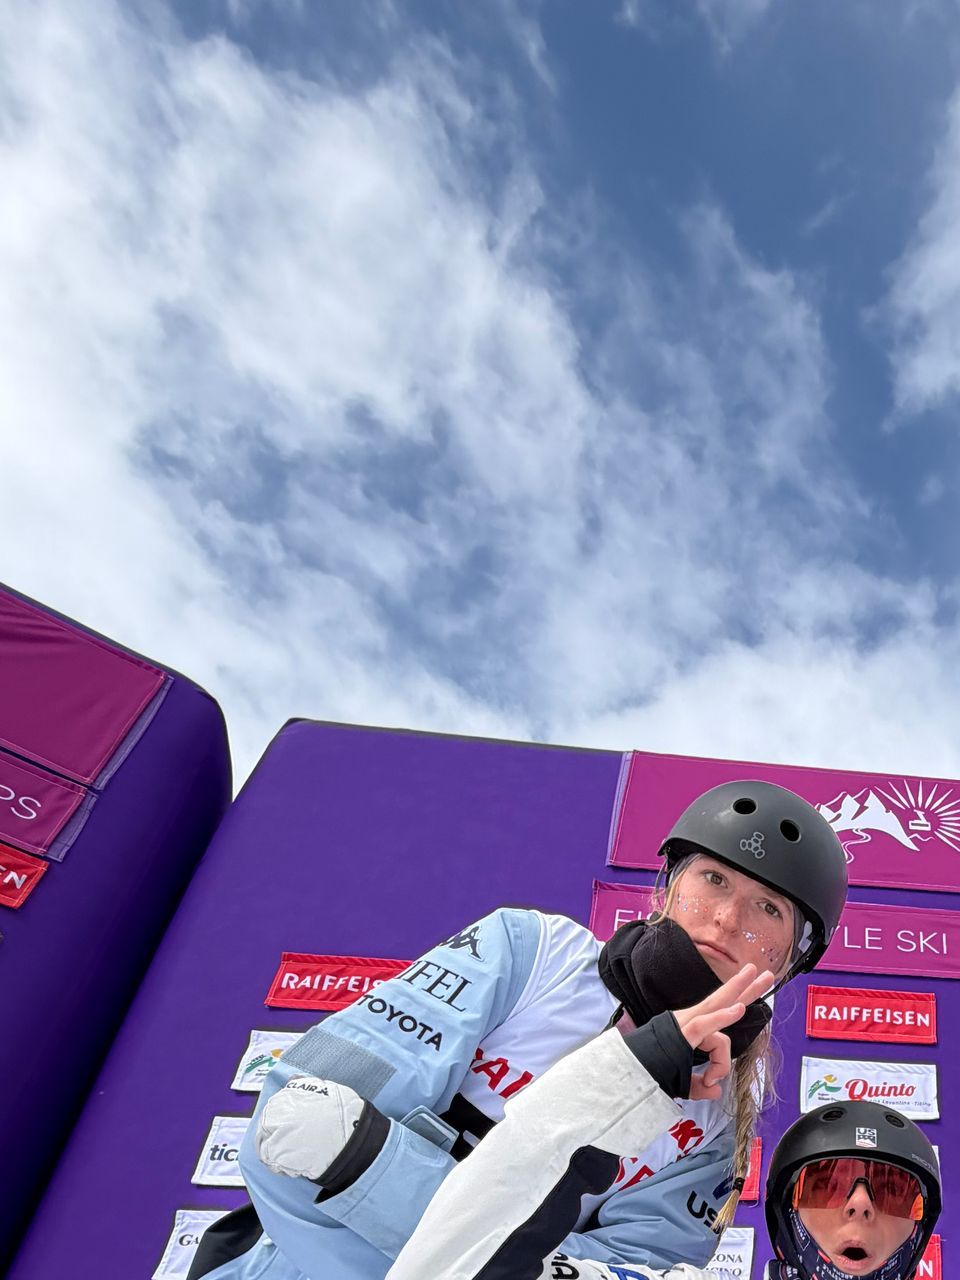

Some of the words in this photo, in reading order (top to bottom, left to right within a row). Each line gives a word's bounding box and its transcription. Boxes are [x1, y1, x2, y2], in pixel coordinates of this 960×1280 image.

[841, 925, 882, 950] LE
[897, 930, 947, 955] SKI
[281, 972, 386, 993] RAIFFEIS
[357, 994, 444, 1052] TOYOTA
[814, 1005, 930, 1028] RAIFFEISEN
[845, 1078, 917, 1101] Quinto
[209, 1143, 239, 1161] tic
